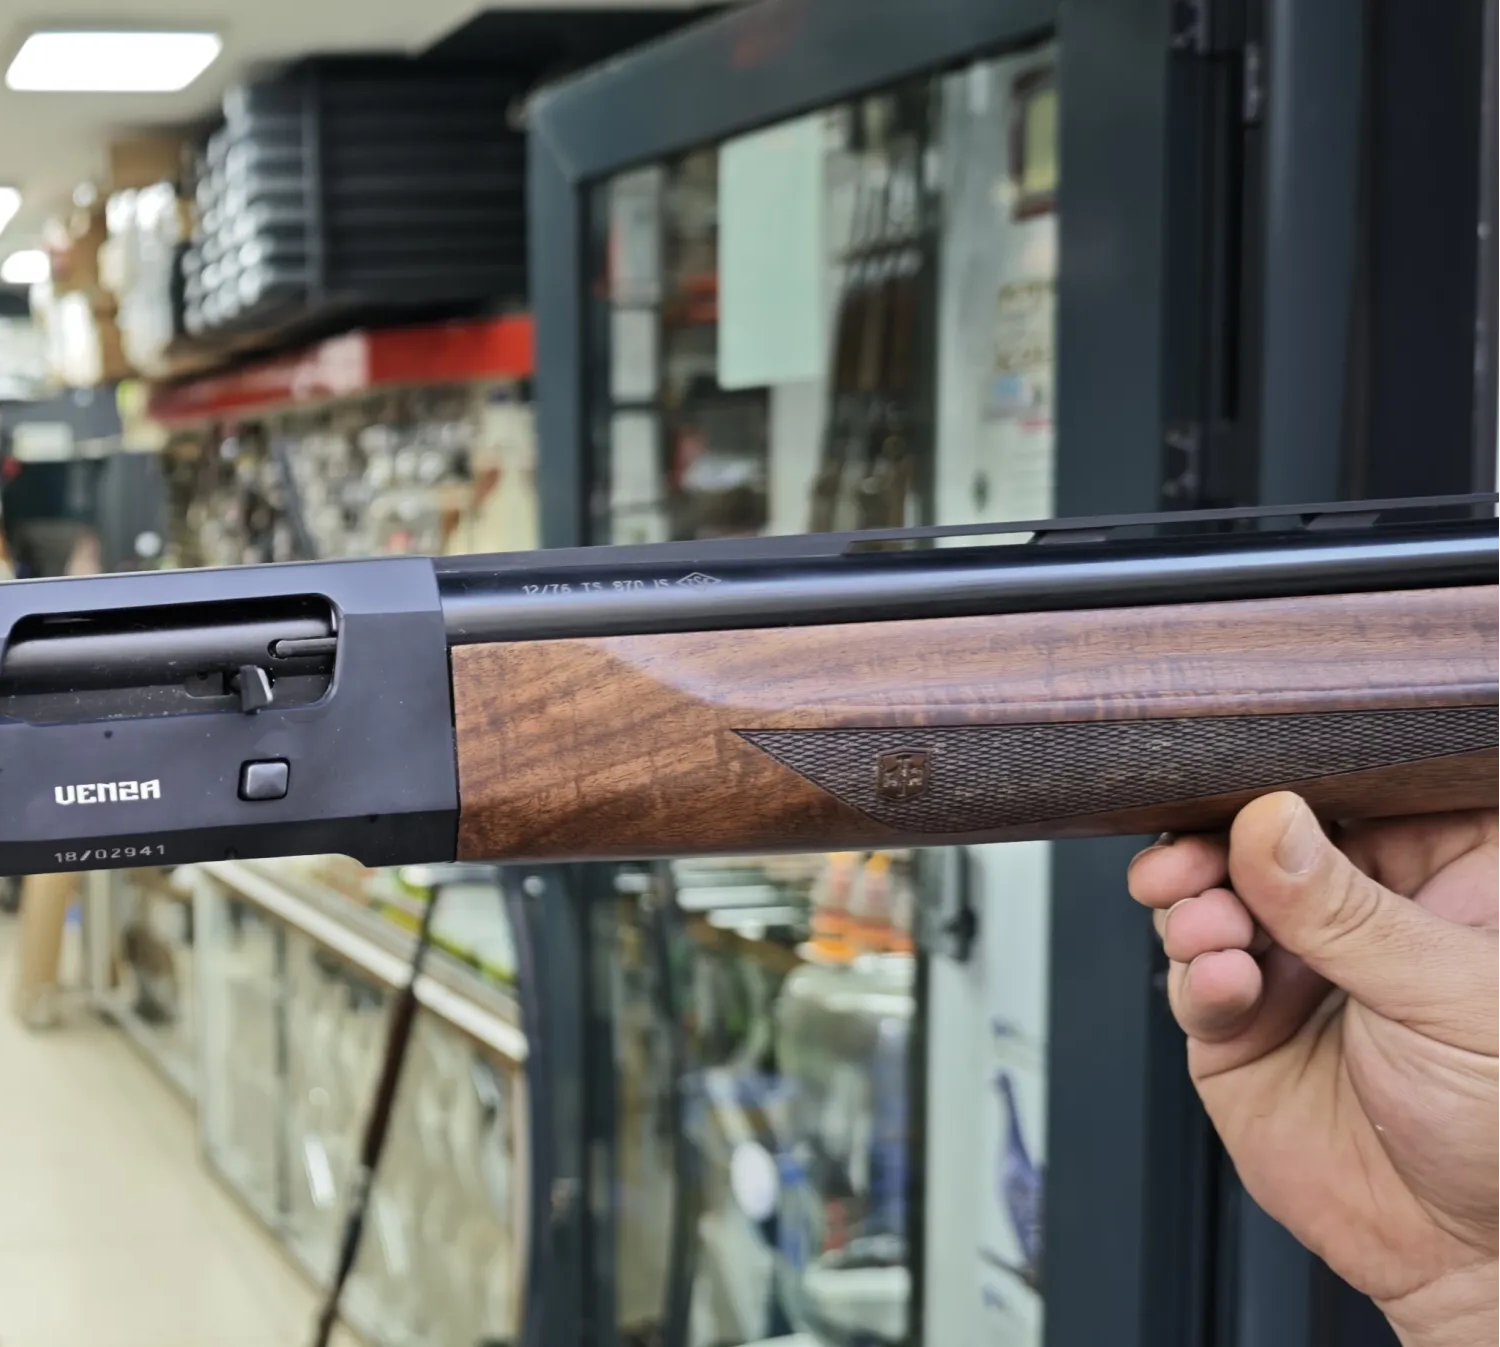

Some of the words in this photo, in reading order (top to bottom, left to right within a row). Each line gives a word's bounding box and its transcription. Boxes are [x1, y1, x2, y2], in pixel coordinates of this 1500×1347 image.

[522, 583, 572, 595] 12/76
[580, 581, 604, 593] TS
[54, 844, 165, 863] 18/02941
